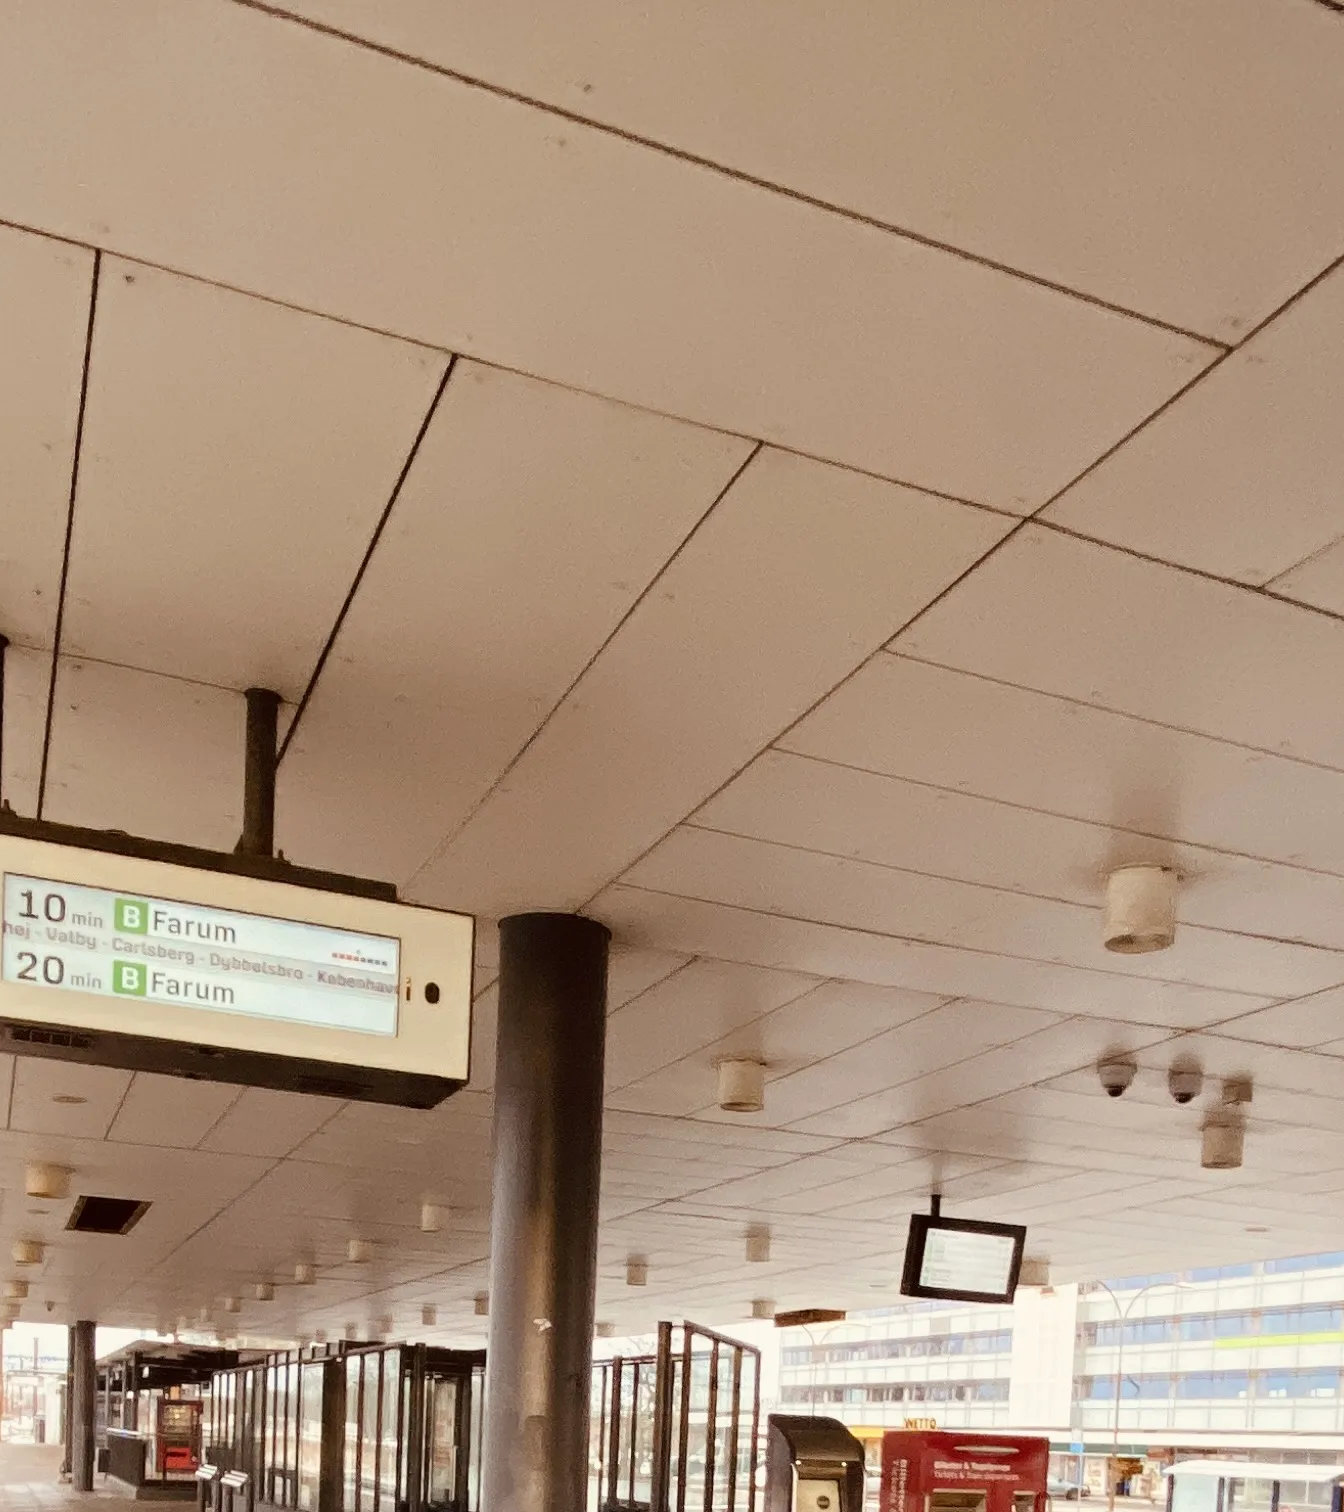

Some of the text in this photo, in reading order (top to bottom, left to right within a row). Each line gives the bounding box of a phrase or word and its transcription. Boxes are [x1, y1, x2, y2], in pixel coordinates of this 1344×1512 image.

[18, 889, 235, 944] 10 min B Farum
[46, 926, 97, 950] Valby
[112, 937, 195, 965] Carlsberg
[17, 951, 234, 1004] 20 min B Farum
[904, 1417, 936, 1430] NETTO
